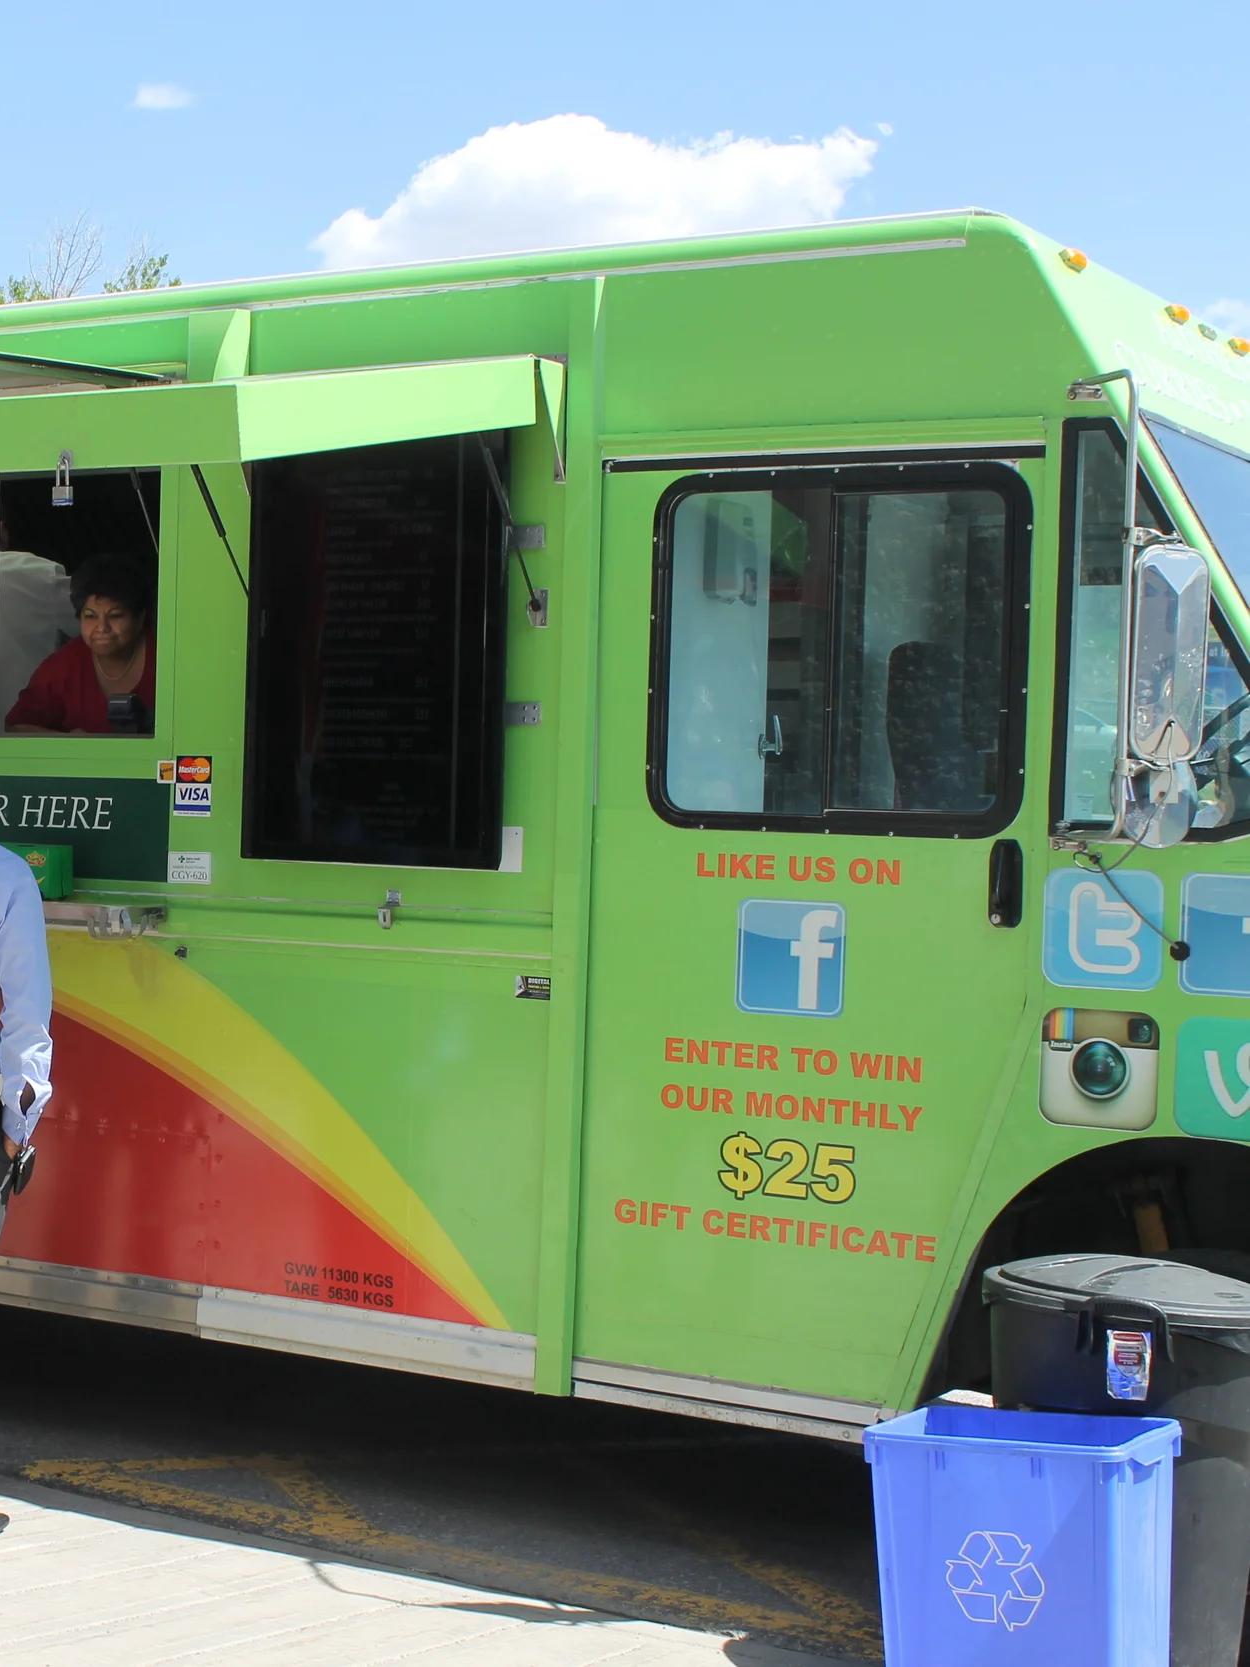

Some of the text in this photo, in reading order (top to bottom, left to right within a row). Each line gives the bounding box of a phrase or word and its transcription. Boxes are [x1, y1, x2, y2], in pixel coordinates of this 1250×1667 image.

[18, 795, 113, 830] HERE
[178, 787, 209, 801] VISA
[696, 852, 901, 885] LIKE US ON
[790, 909, 838, 1010] f
[664, 1037, 922, 1083] ENTER TO WIN
[660, 1084, 923, 1132] OUR MONTHLY
[717, 1131, 856, 1204] $25
[614, 1198, 937, 1263] GIFT CERTIFICATE
[284, 1262, 394, 1289] GVW 11300 KGS
[284, 1280, 394, 1307] TARE 5630 KGS
